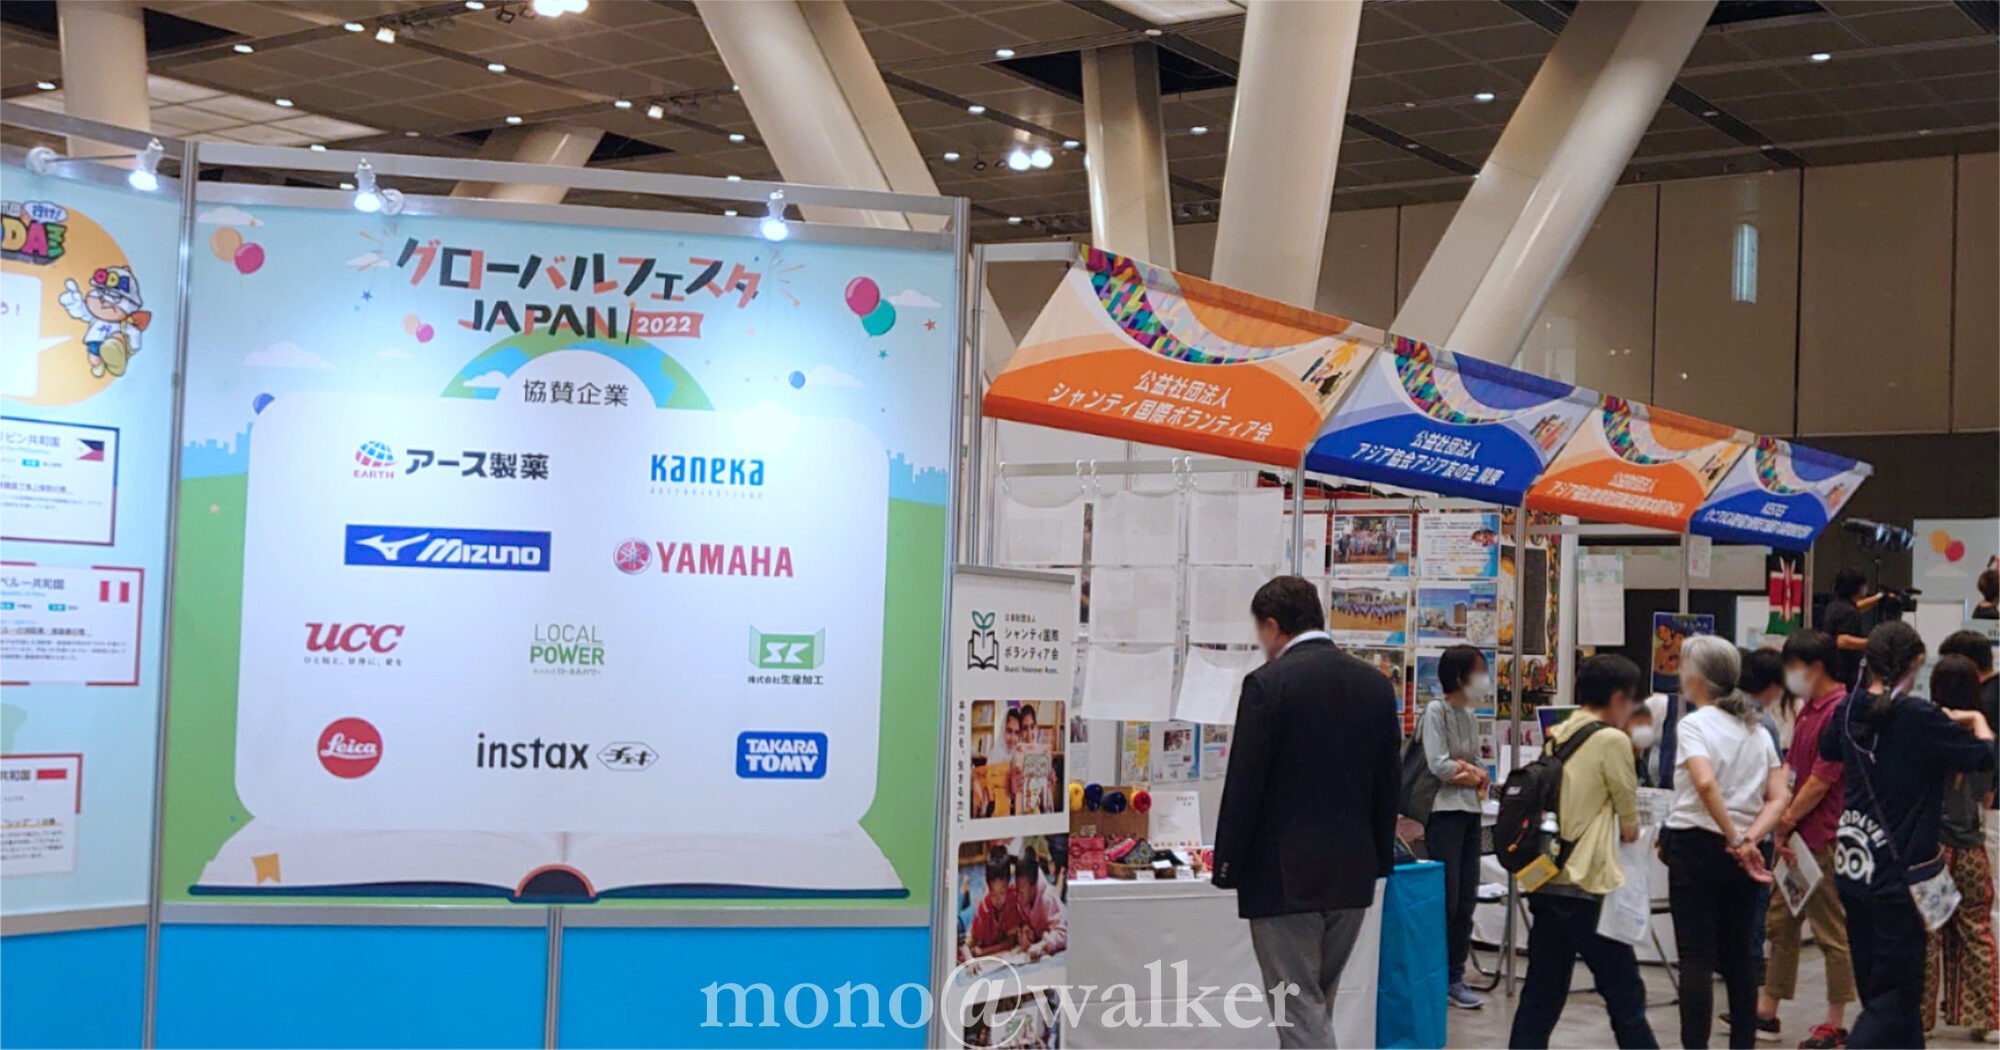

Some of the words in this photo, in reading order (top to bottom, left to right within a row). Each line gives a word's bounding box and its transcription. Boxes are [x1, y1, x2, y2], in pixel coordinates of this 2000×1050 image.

[1, 217, 48, 257] DA
[398, 237, 763, 308] グローバルフェスタ
[459, 299, 618, 339] JAPAN
[635, 314, 692, 335] 2022
[524, 379, 628, 407] 協賛企業
[1134, 369, 1232, 409] 公益社団法人
[1048, 382, 1274, 442] シャンティ国際ボランティア会
[1410, 430, 1481, 460] 公益社団法人
[353, 469, 395, 480] EARTH
[406, 448, 549, 481] アース製薬
[1352, 442, 1480, 482] アジア協会アジア友の会
[657, 541, 794, 577] YAMAHA
[534, 623, 603, 643] LOCAL
[1005, 628, 1059, 642] シャンティ国際
[529, 643, 605, 666] POWER
[1005, 646, 1059, 660] ボランティア会
[320, 727, 378, 757] Leica
[477, 732, 589, 770] instax
[746, 738, 819, 755] TAKARA
[745, 754, 818, 773] TOMY
